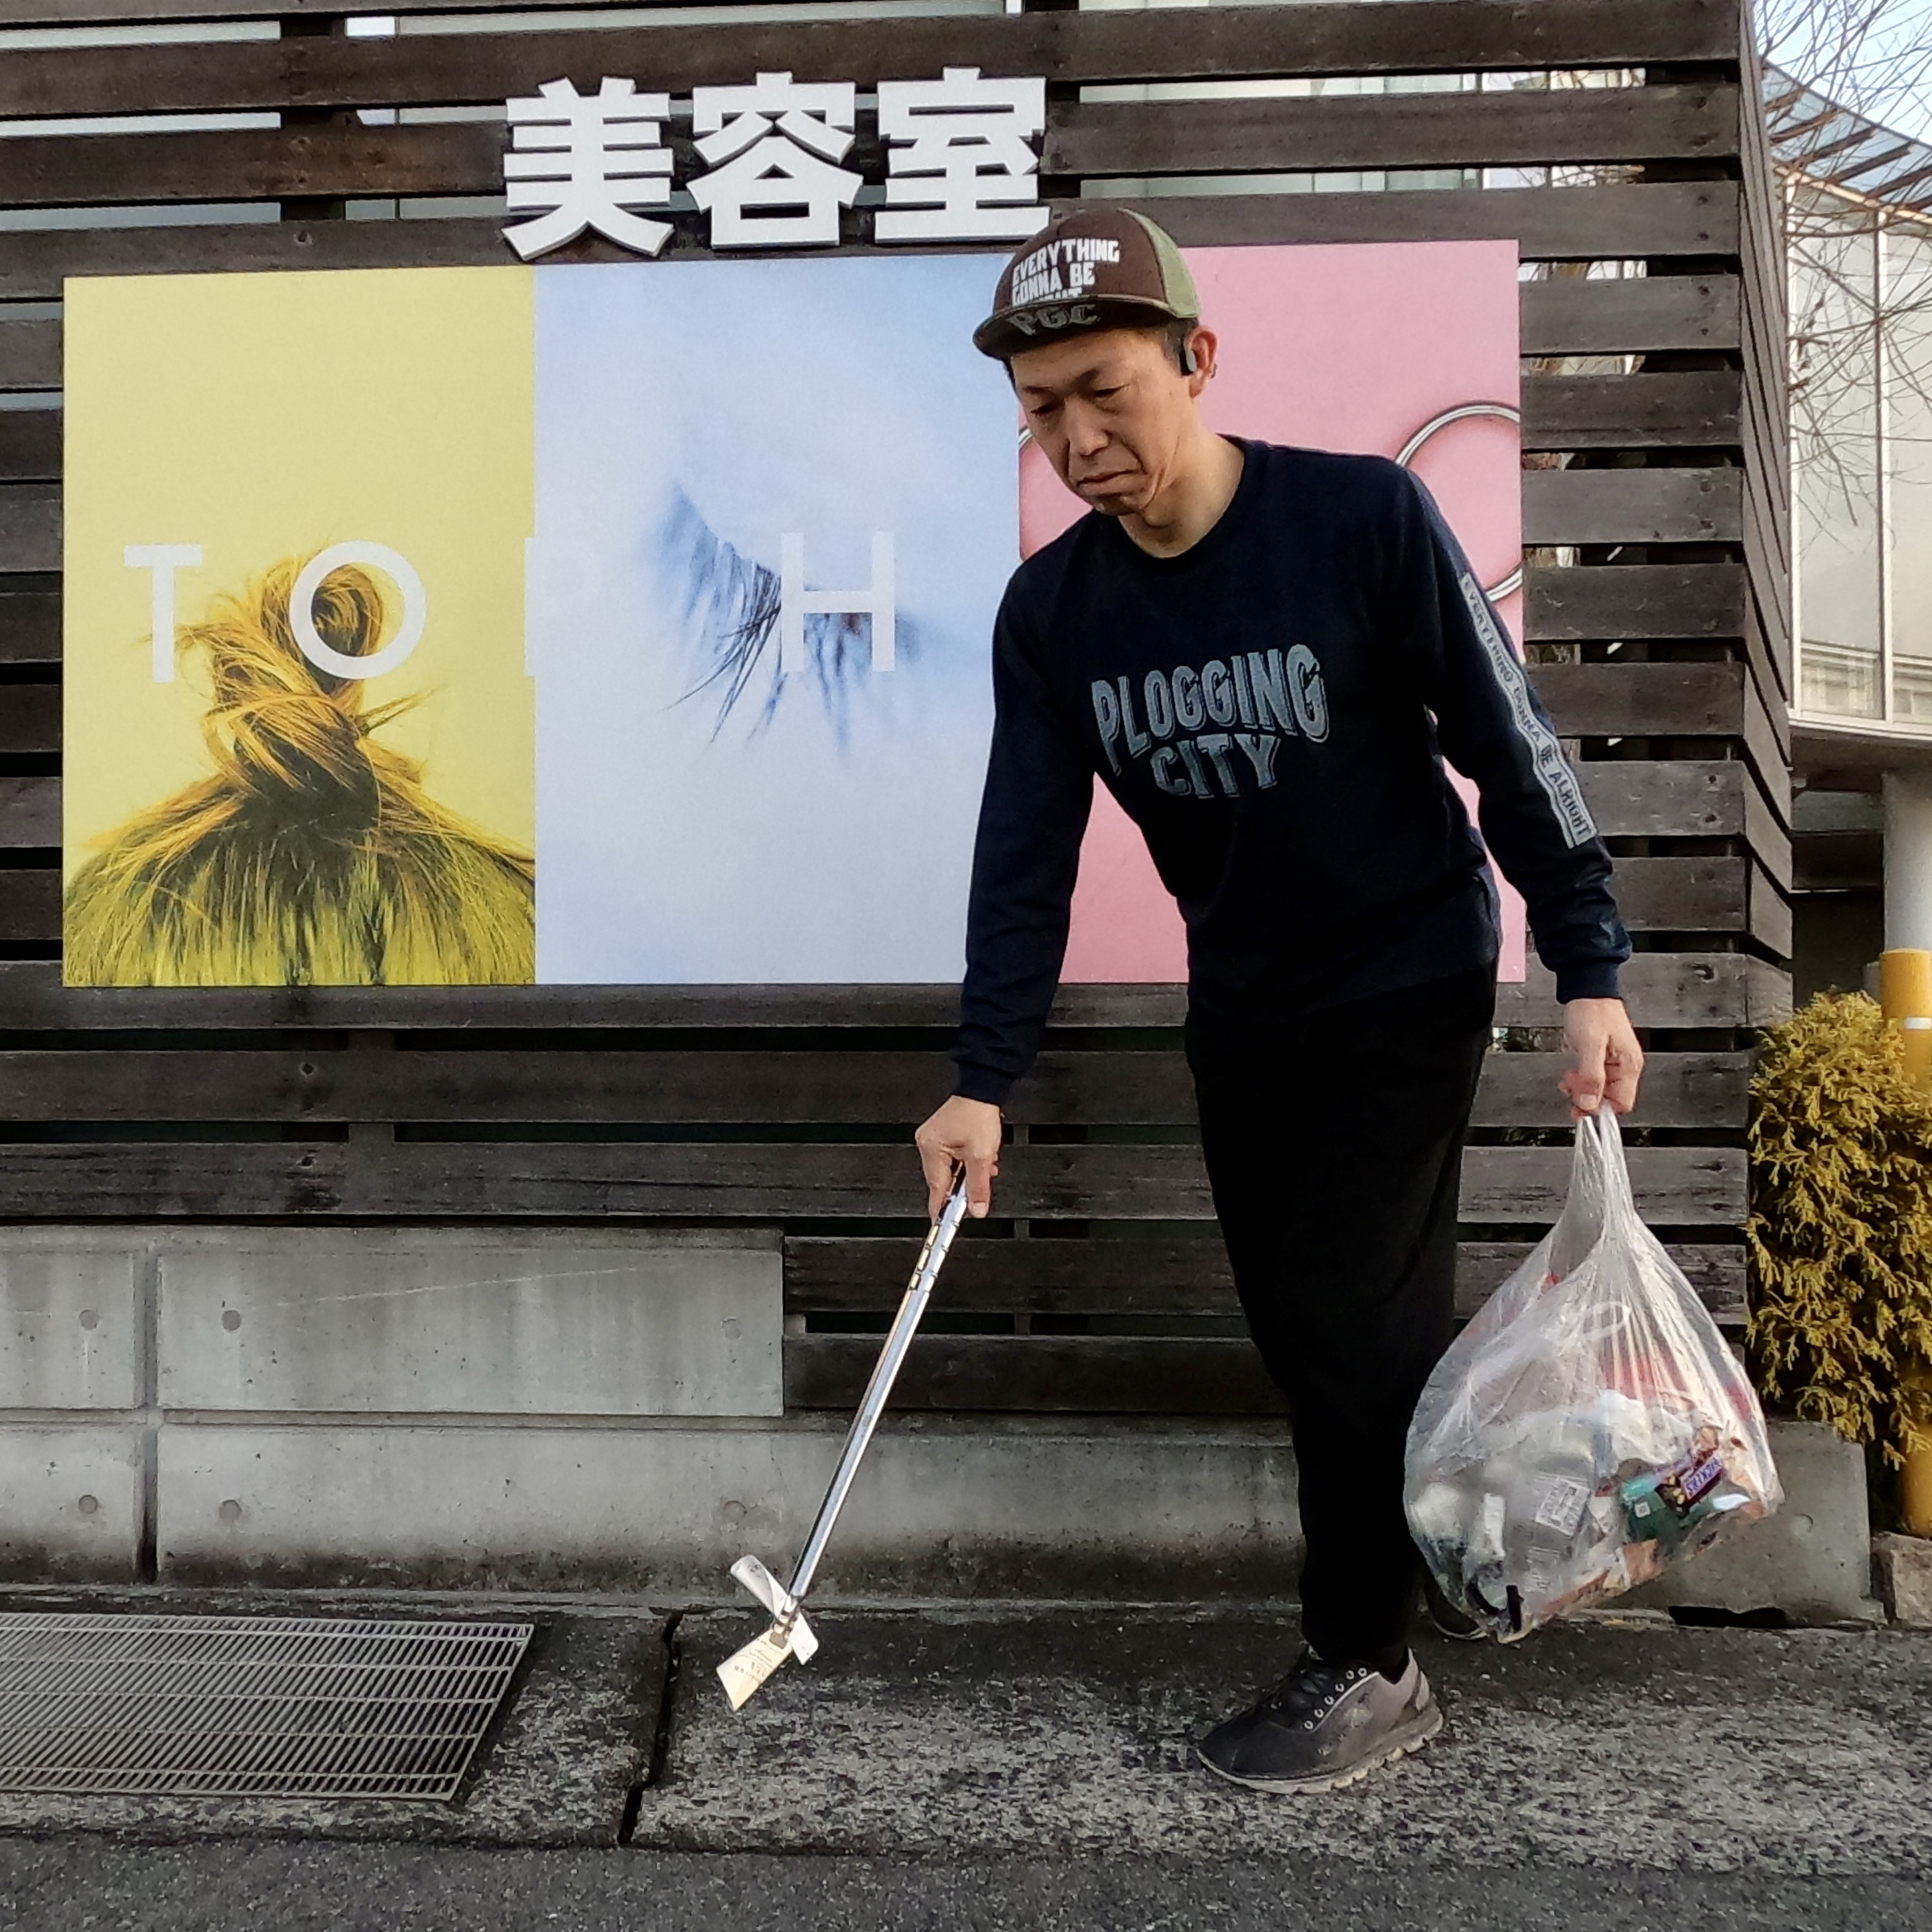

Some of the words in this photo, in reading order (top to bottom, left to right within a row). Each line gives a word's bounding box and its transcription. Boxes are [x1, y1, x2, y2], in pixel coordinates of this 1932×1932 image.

[502, 66, 1050, 261] 美容室
[1012, 238, 1120, 287] EVERYTHING
[1012, 267, 1063, 308] GONNA
[1070, 261, 1095, 288] BE
[1091, 644, 1330, 776] PLOGGING
[1150, 732, 1282, 799] CITY
[1549, 771, 1590, 835] ALRIGHT
